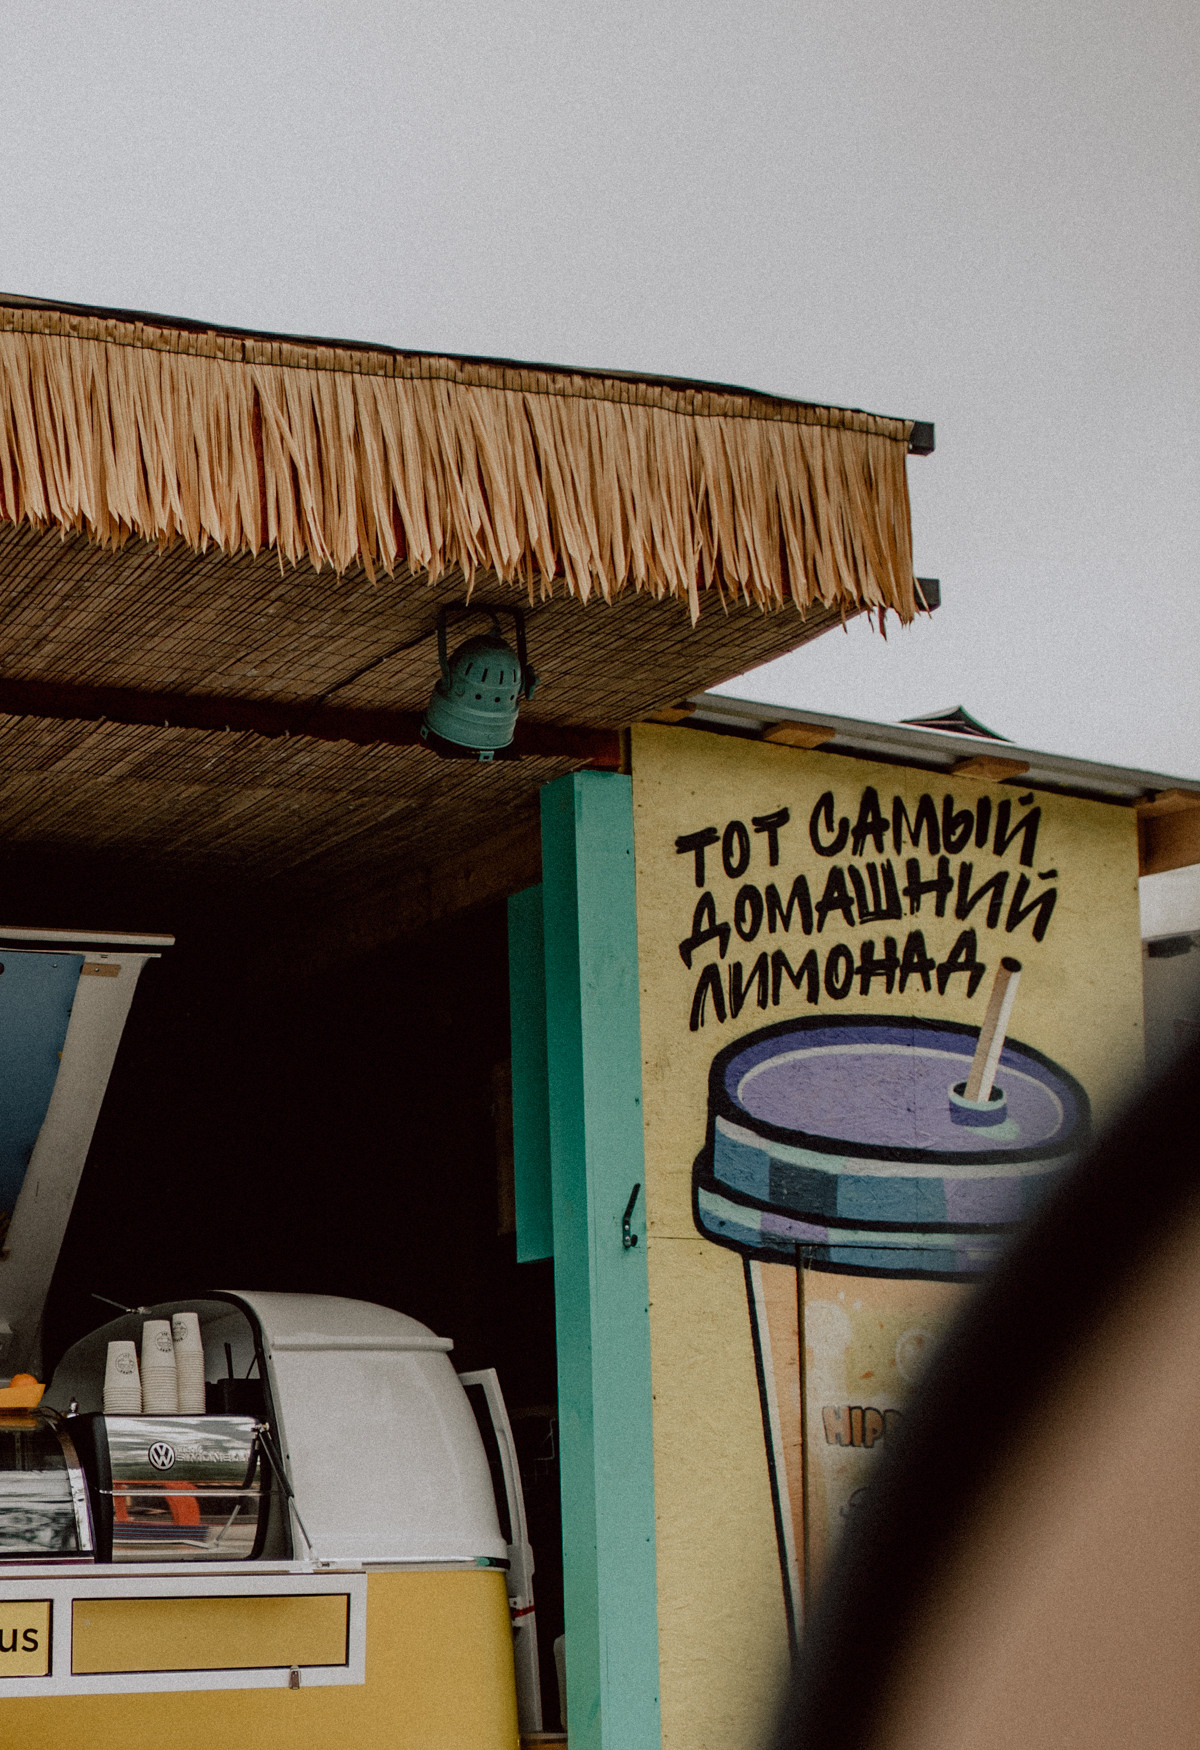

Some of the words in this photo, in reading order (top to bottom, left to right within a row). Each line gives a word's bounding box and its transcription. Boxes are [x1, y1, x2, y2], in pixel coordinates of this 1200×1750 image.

[676, 807, 790, 887] ТОТ
[810, 787, 1043, 868] САМЫЙ
[679, 857, 1058, 970] ДОМАШНИЙ
[689, 928, 987, 1031] ЛИМОНАД
